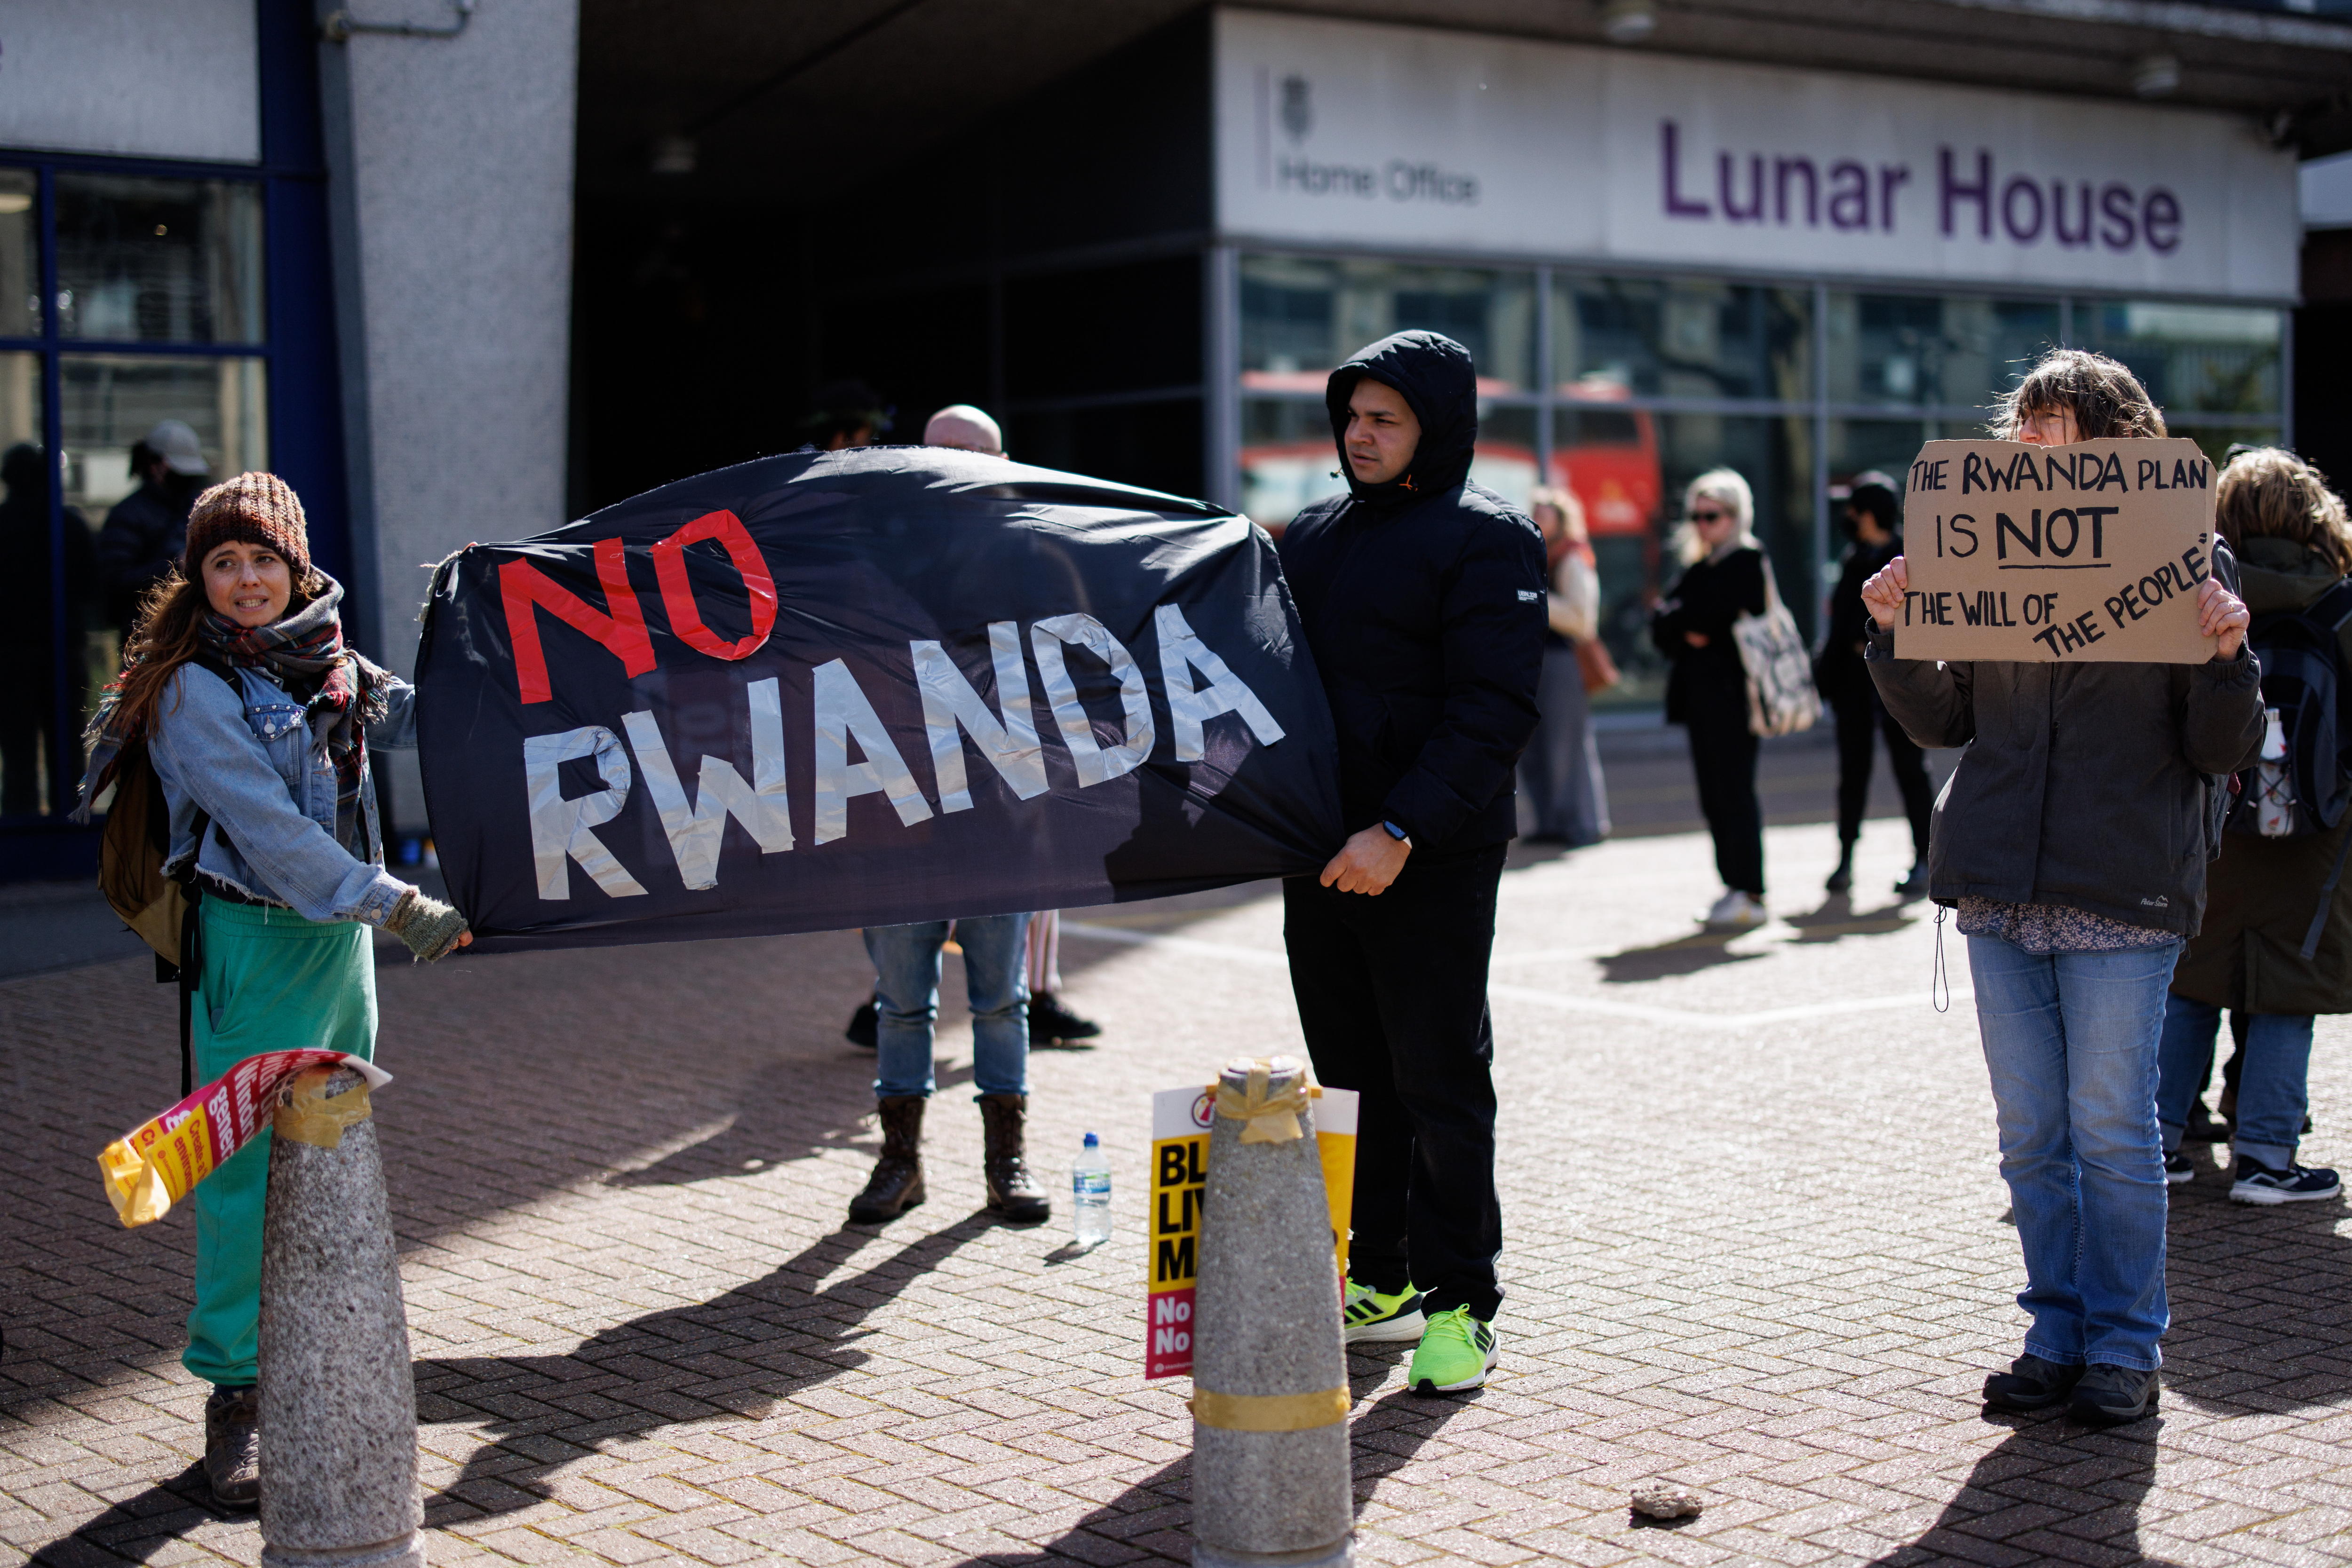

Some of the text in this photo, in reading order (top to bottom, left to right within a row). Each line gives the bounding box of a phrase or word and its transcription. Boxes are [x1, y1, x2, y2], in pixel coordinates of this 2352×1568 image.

[1277, 152, 1481, 206] Home Office
[1660, 117, 2185, 257] Lunar House
[1912, 451, 2209, 495] THE RWANDA PLAN
[1936, 506, 2119, 560] IS NOT
[499, 509, 778, 705] NO
[1903, 591, 2059, 627] THE WILL OF
[2032, 610, 2107, 658] THE
[523, 603, 1286, 900] RWANDA
[2154, 900, 2168, 908] Storm
[1158, 1236, 1198, 1282] M
[1156, 1297, 1191, 1325] No
[1155, 1327, 1190, 1355] No
